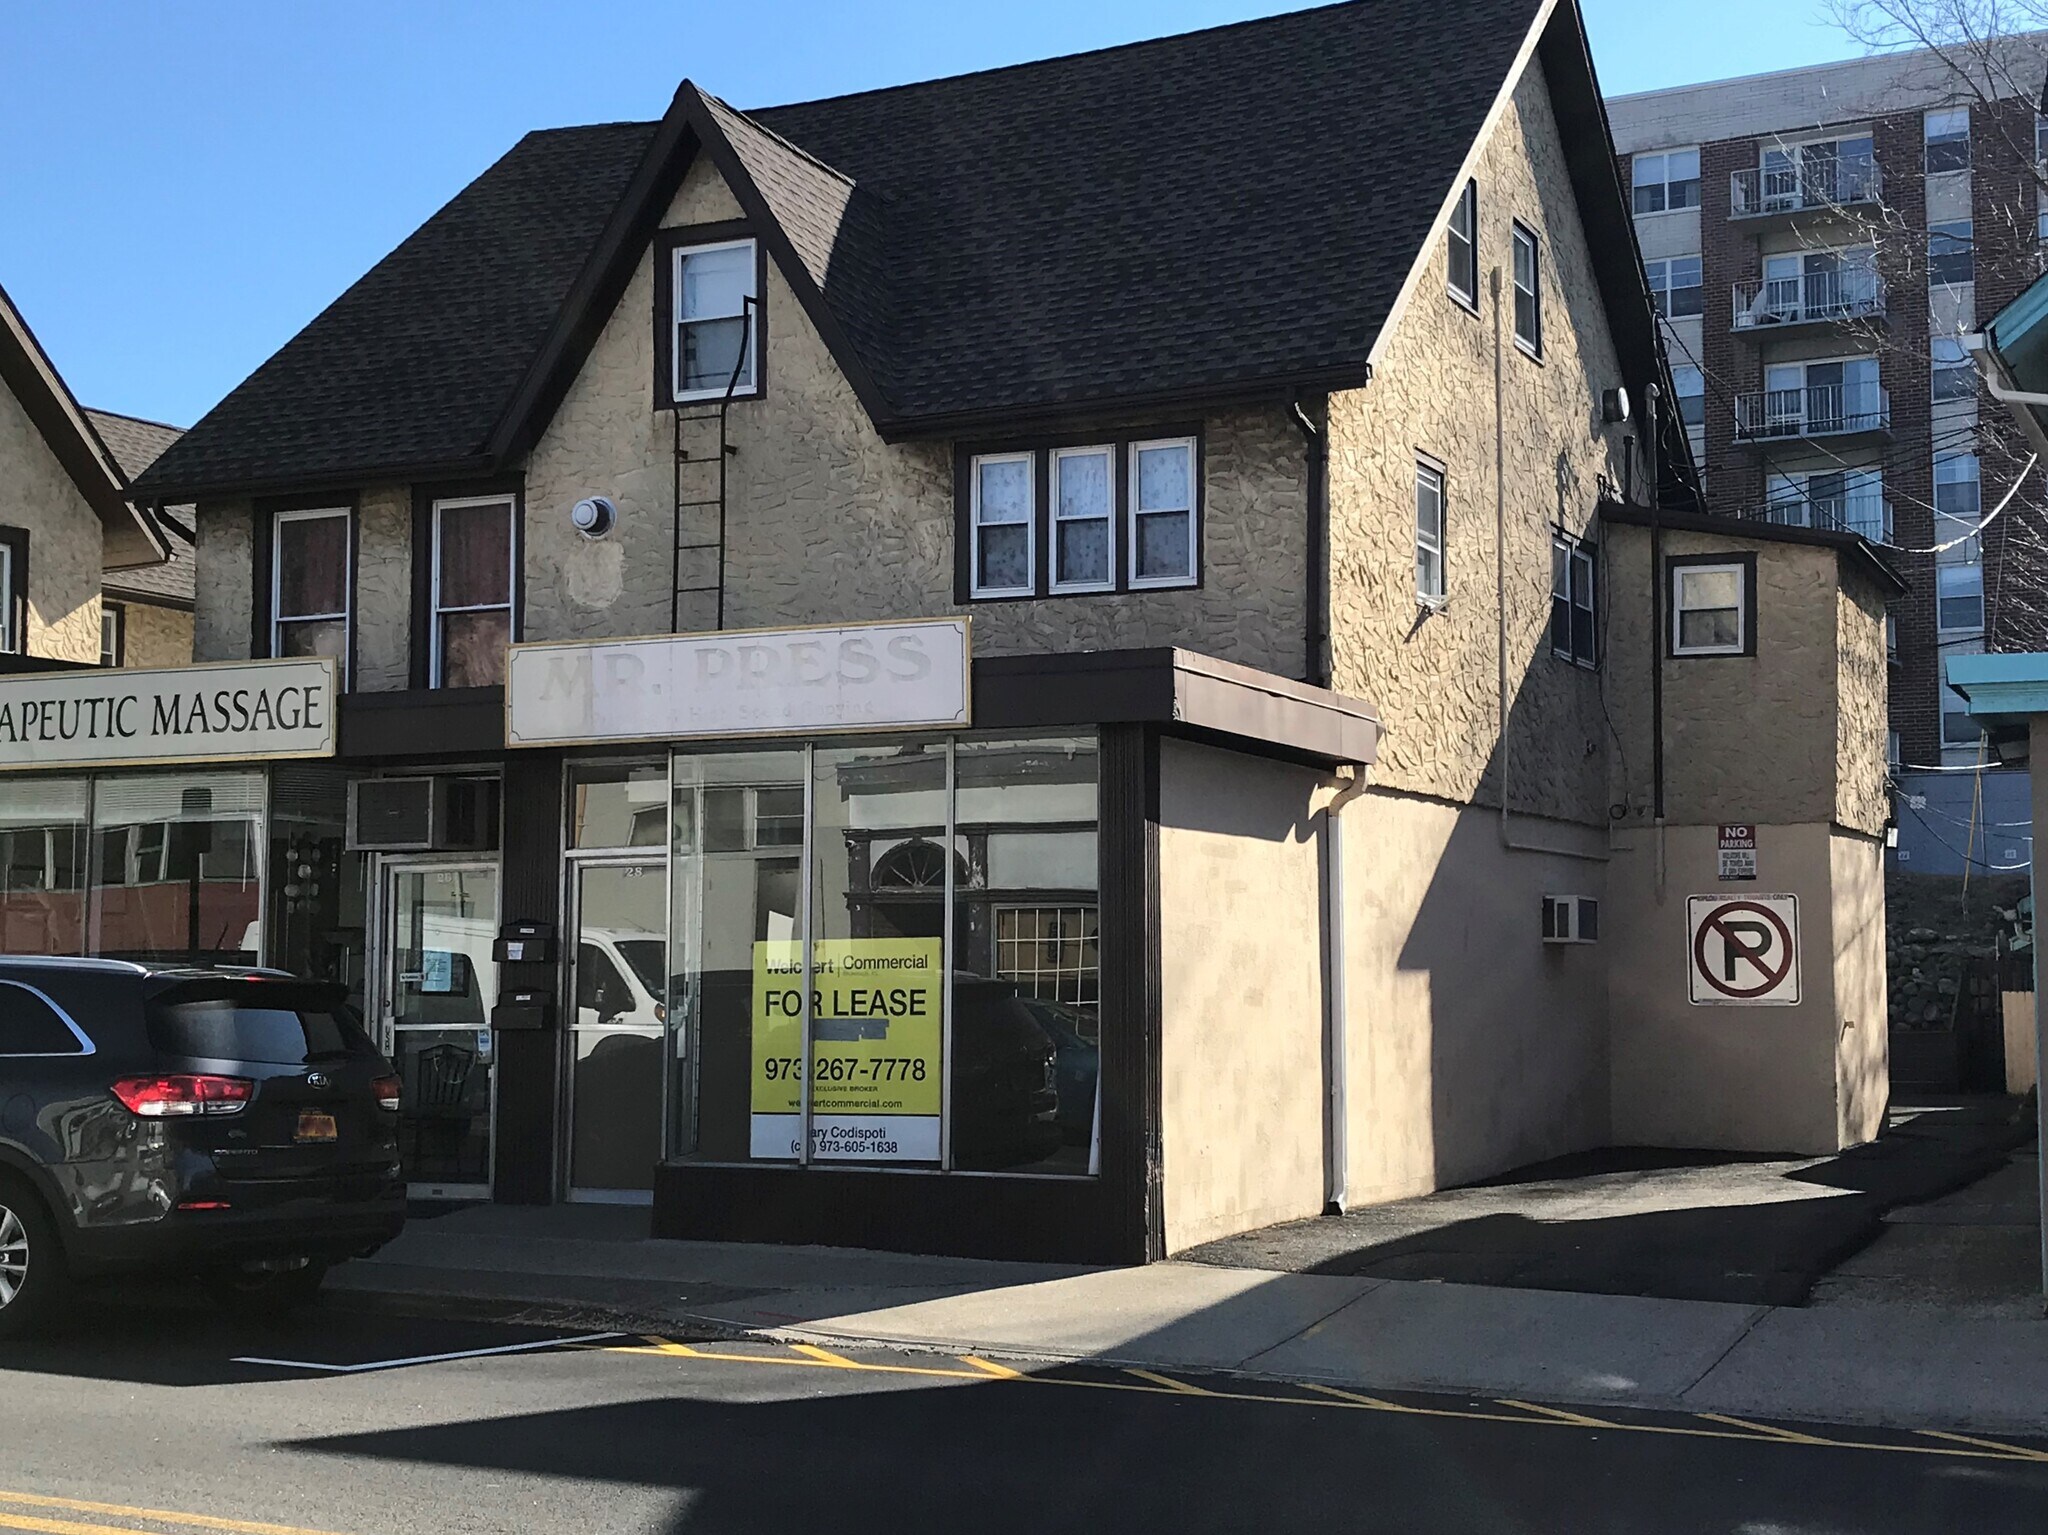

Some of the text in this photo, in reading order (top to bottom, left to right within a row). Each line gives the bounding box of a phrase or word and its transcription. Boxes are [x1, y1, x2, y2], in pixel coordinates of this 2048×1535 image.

[151, 686, 323, 735] MASSAGE
[1725, 826, 1748, 838] NO
[1720, 839, 1753, 849] PARKING
[765, 958, 834, 974] Weicert
[843, 954, 928, 969] Commercial
[765, 989, 927, 1017] FOR LEASE
[811, 1126, 886, 1140] ary Codispoti
[820, 1141, 898, 1153] 973-605-1638
